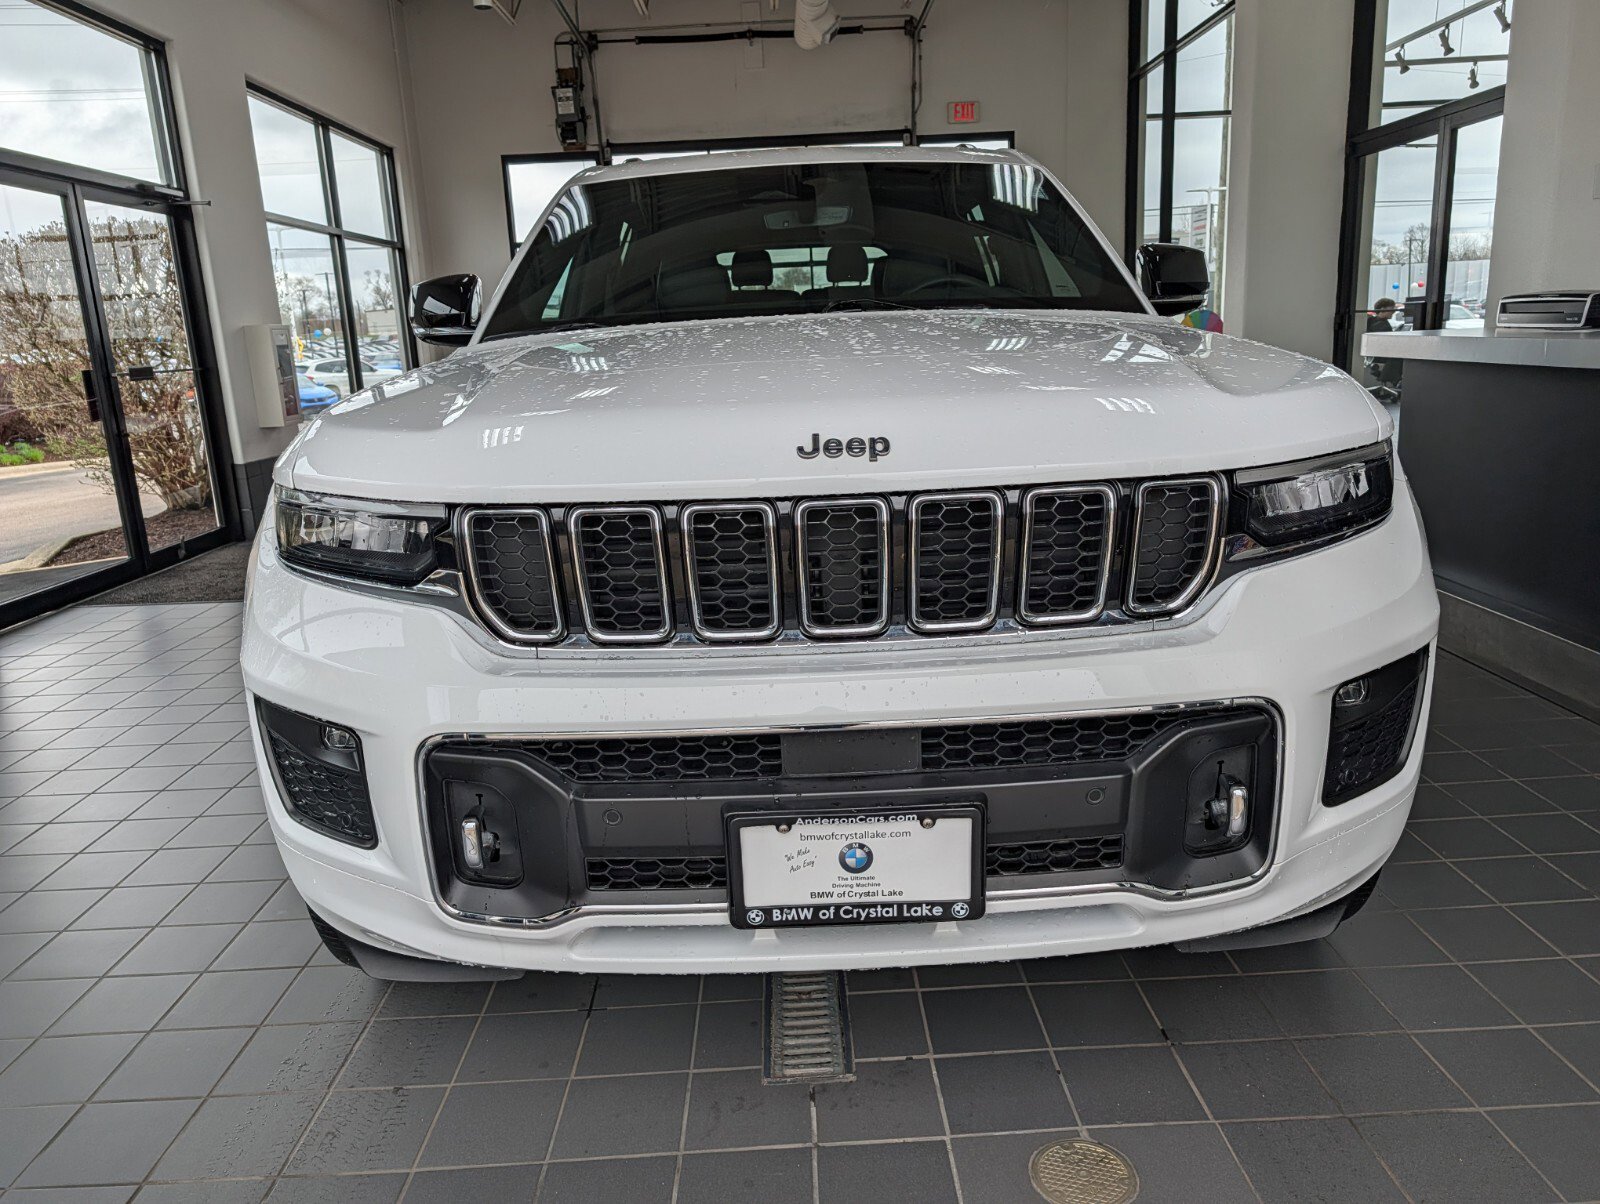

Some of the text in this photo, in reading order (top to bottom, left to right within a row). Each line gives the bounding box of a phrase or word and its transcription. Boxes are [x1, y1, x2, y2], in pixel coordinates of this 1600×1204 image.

[953, 102, 975, 121] EXIT
[796, 433, 890, 462] Jeep
[795, 813, 917, 826] AndersonCars.com
[799, 830, 912, 842] bmwofcrystallake.com
[810, 888, 905, 900] BMW of Crystal Lake
[772, 903, 944, 922] BMW of Crystal Lake
